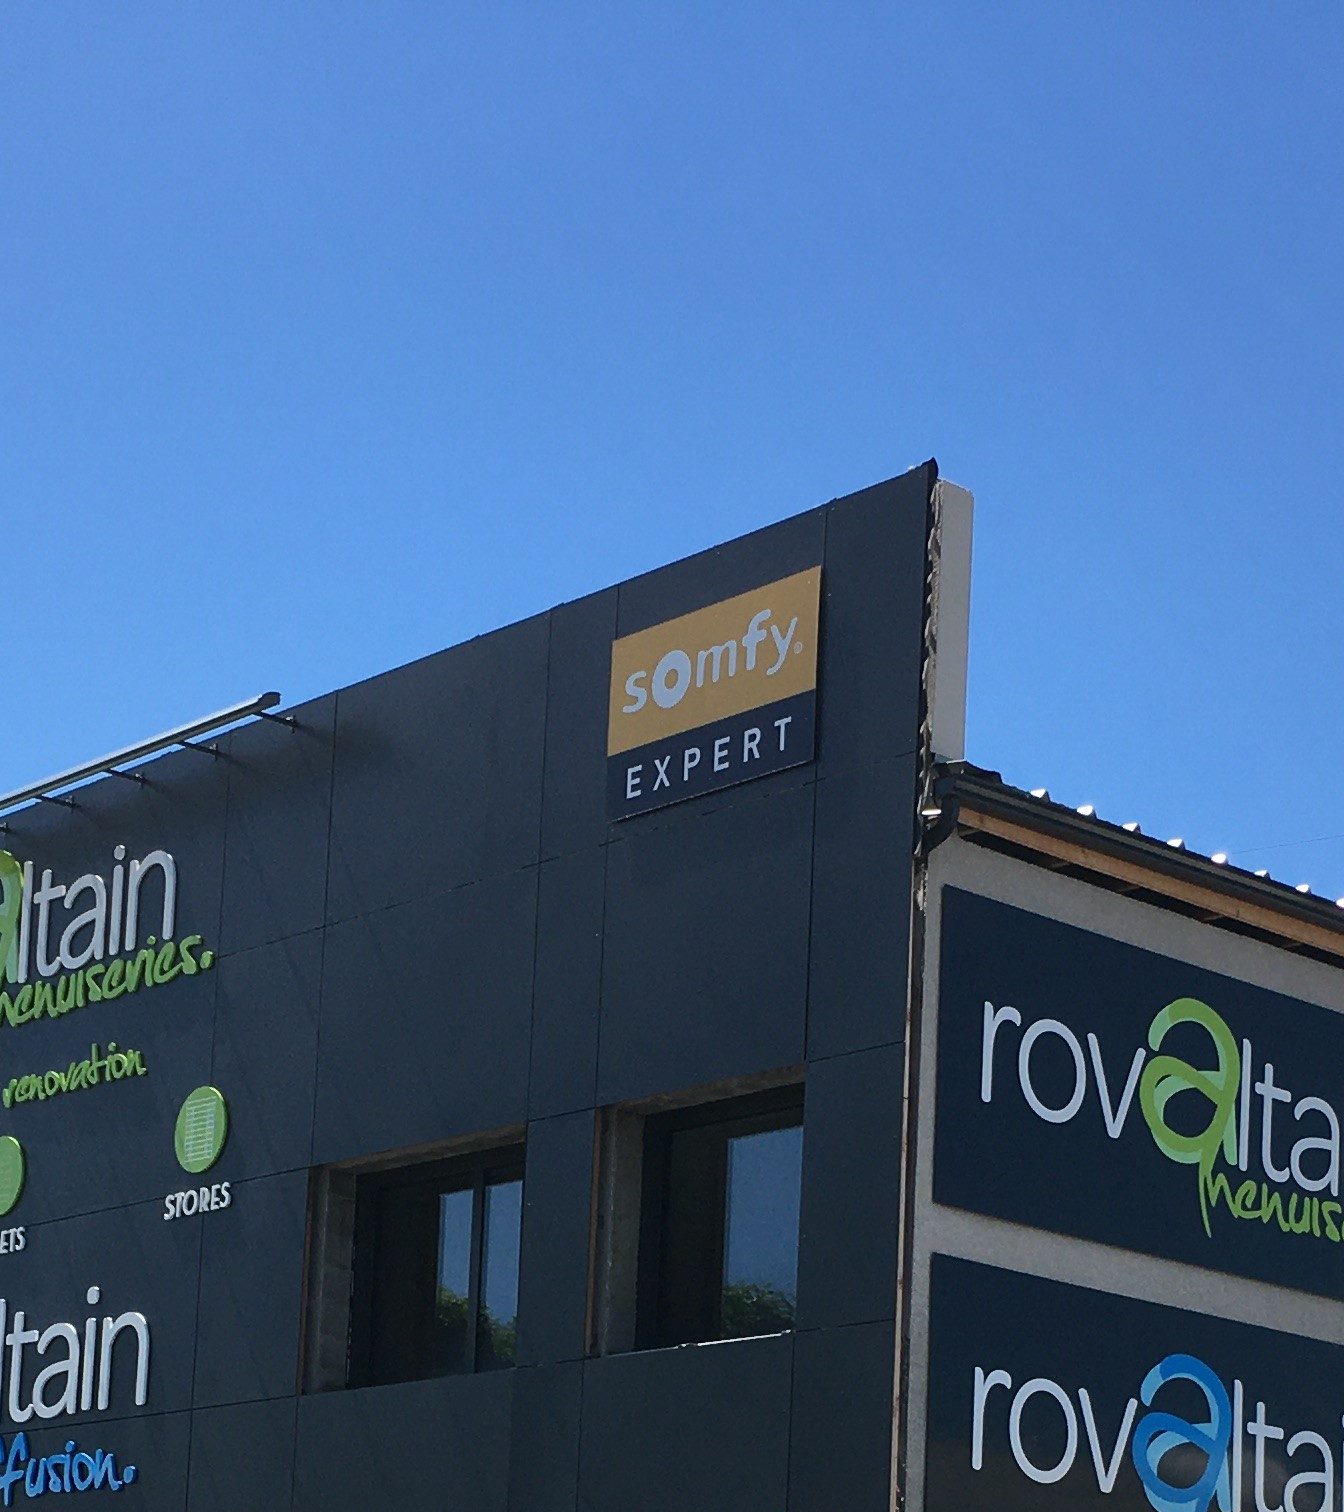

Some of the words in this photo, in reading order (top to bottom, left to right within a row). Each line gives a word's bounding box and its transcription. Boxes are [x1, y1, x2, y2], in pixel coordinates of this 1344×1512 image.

[626, 716, 792, 799] EXPERT
[2, 1041, 147, 1109] renovation
[163, 1181, 232, 1221] STORES
